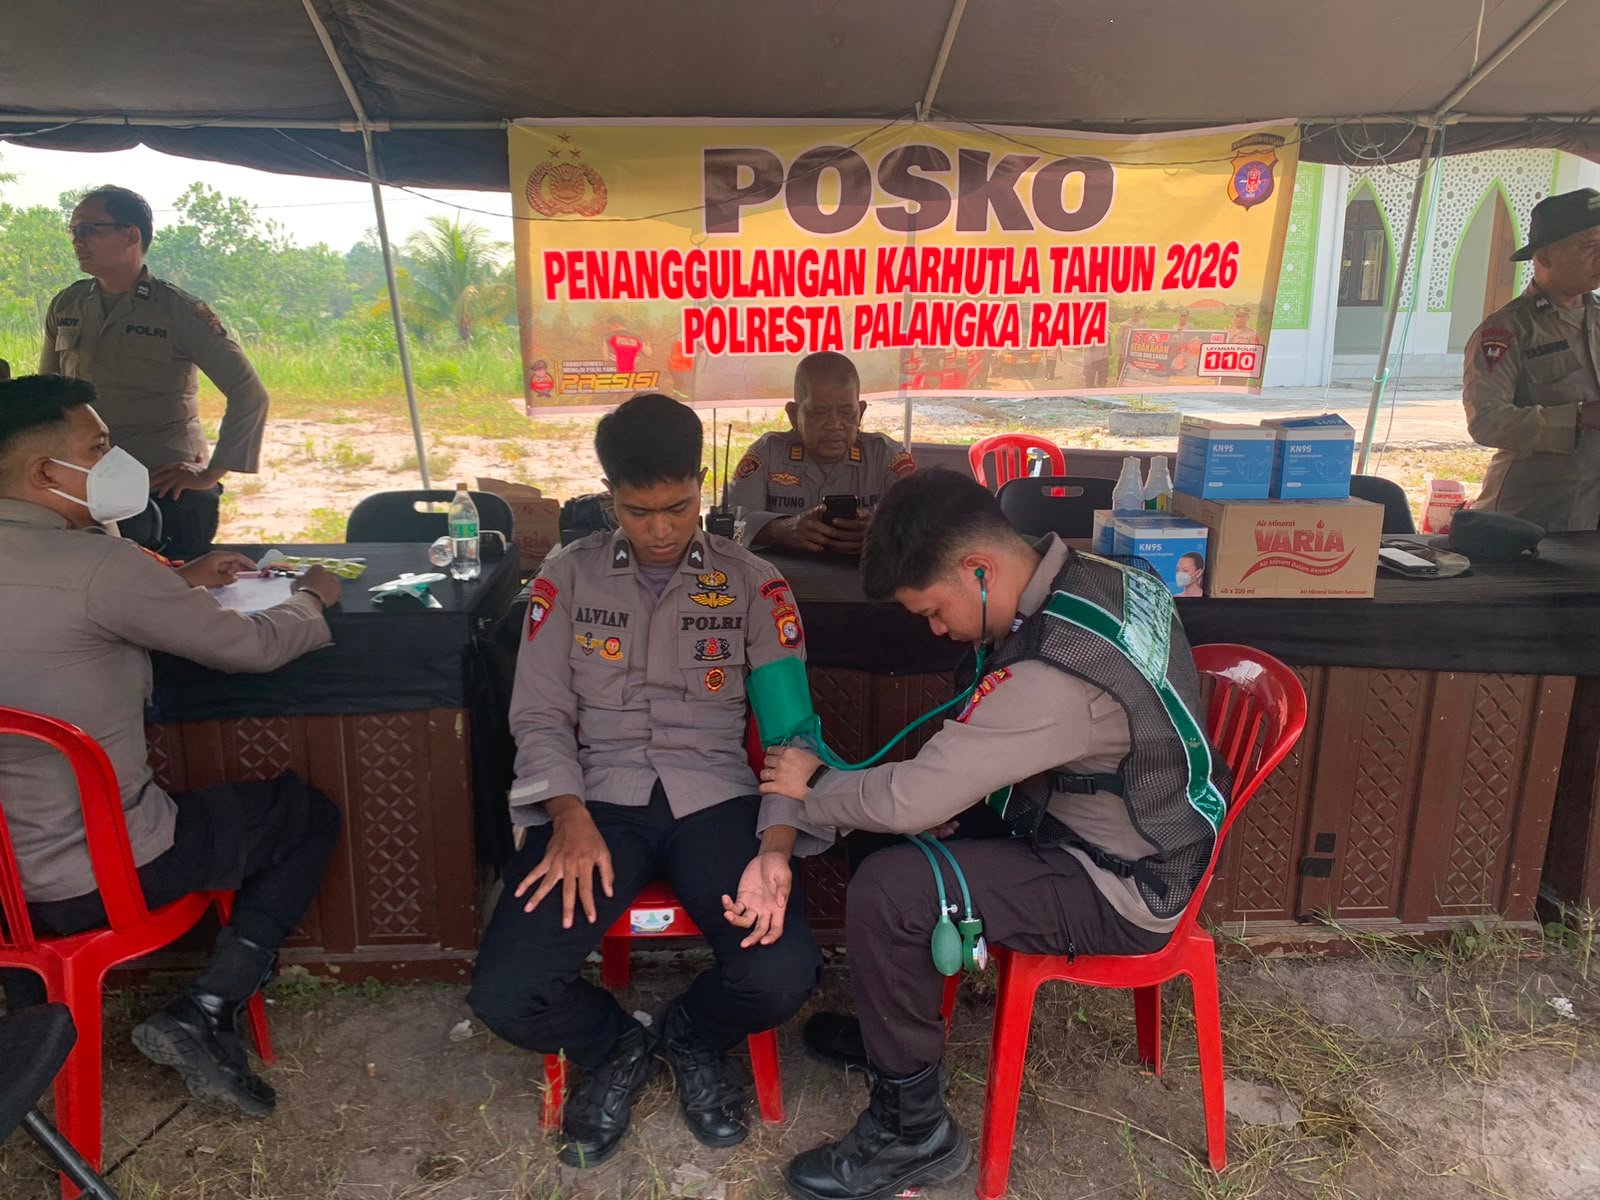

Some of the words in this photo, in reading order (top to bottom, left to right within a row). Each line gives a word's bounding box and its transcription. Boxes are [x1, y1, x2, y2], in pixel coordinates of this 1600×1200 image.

[703, 145, 1114, 234] POSKO
[544, 249, 866, 299] PENANGGULANGAN
[876, 247, 1040, 295] KARHUTLA
[1050, 246, 1155, 294] TAHUN
[1161, 241, 1239, 290] 2026
[126, 325, 167, 338] POLRI
[684, 305, 843, 354] POLRESTA
[854, 302, 1020, 349] PALANGKA
[1030, 302, 1107, 347] RAYA
[1206, 353, 1255, 369] 110
[561, 372, 660, 389] PRESISI
[1212, 444, 1234, 453] KN95
[1290, 445, 1312, 453] KN95
[1139, 543, 1162, 551] KN95
[1310, 565, 1339, 574] Kemasan
[575, 607, 629, 628] ALVIAN
[681, 617, 742, 630] POLRI
